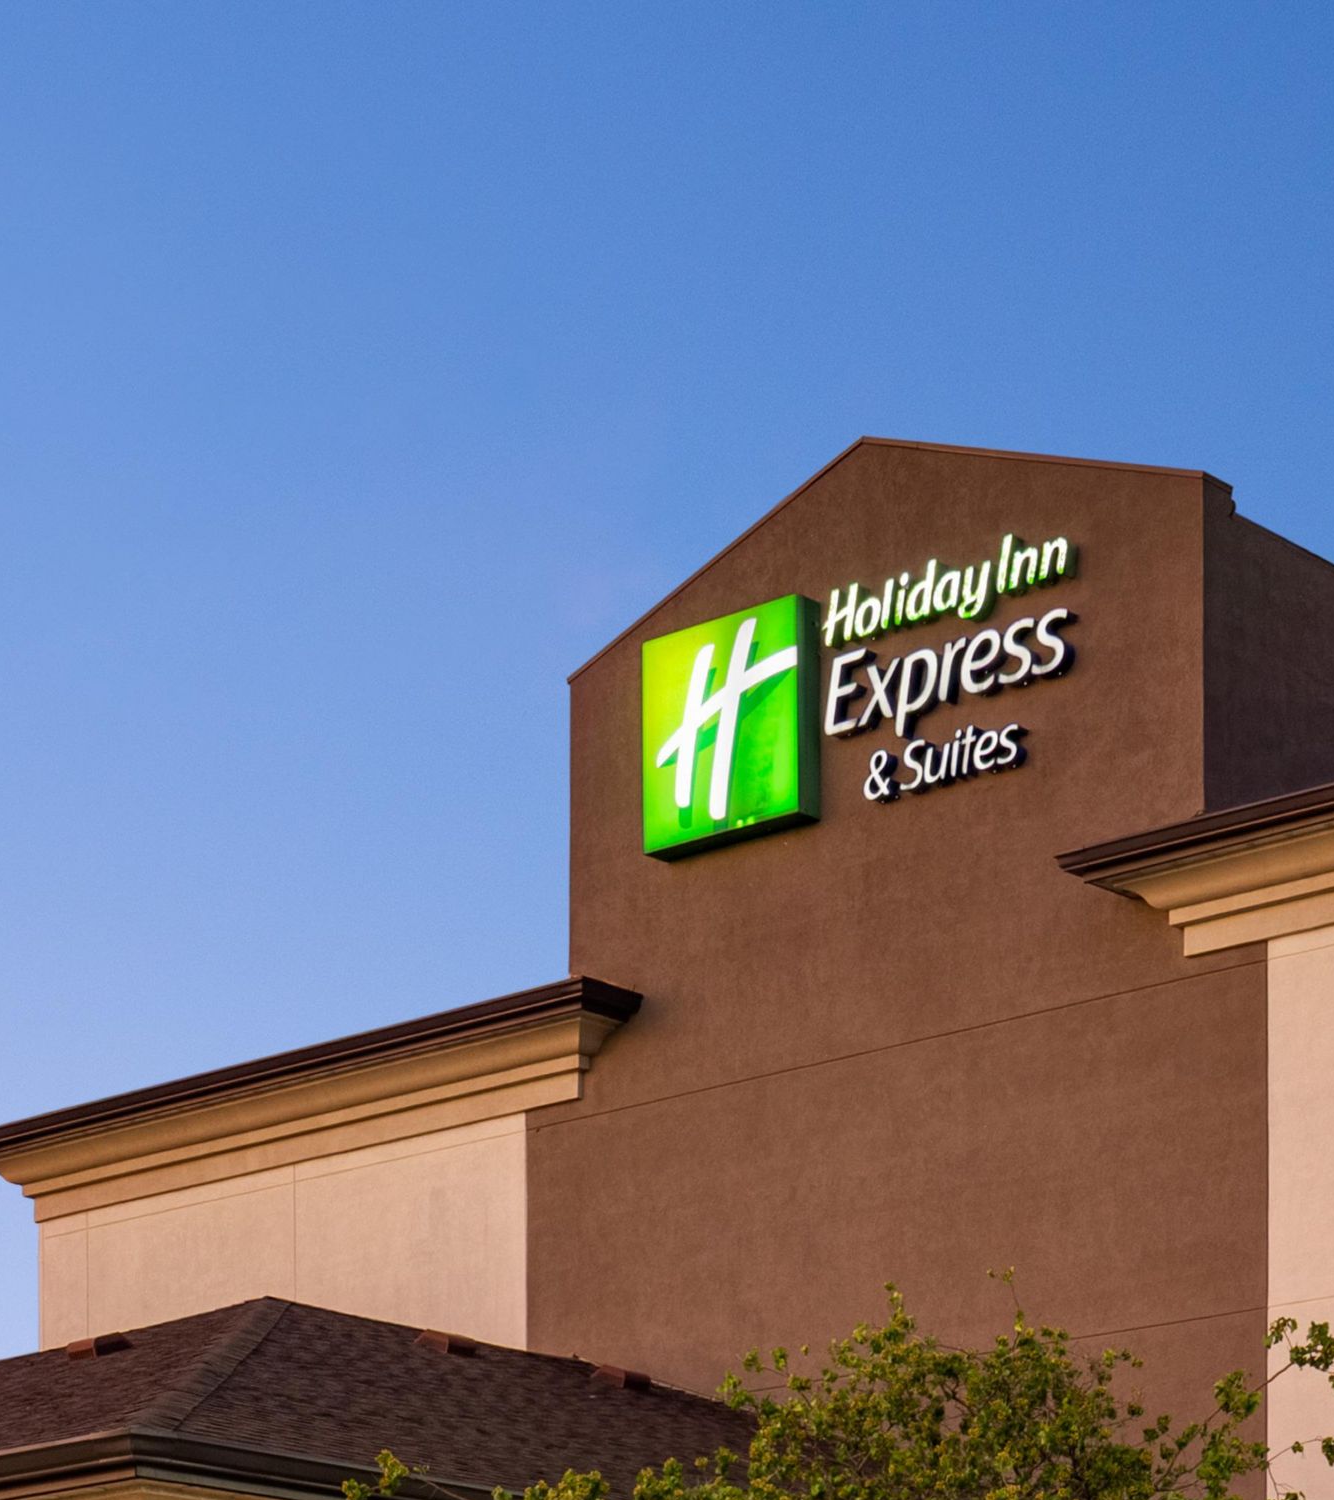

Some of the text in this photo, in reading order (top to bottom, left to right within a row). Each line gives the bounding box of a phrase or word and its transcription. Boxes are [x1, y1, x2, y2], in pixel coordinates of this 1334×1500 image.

[822, 533, 1068, 647] Holiday Inn
[824, 608, 1068, 738] Express
[863, 723, 1019, 801] & Suites
